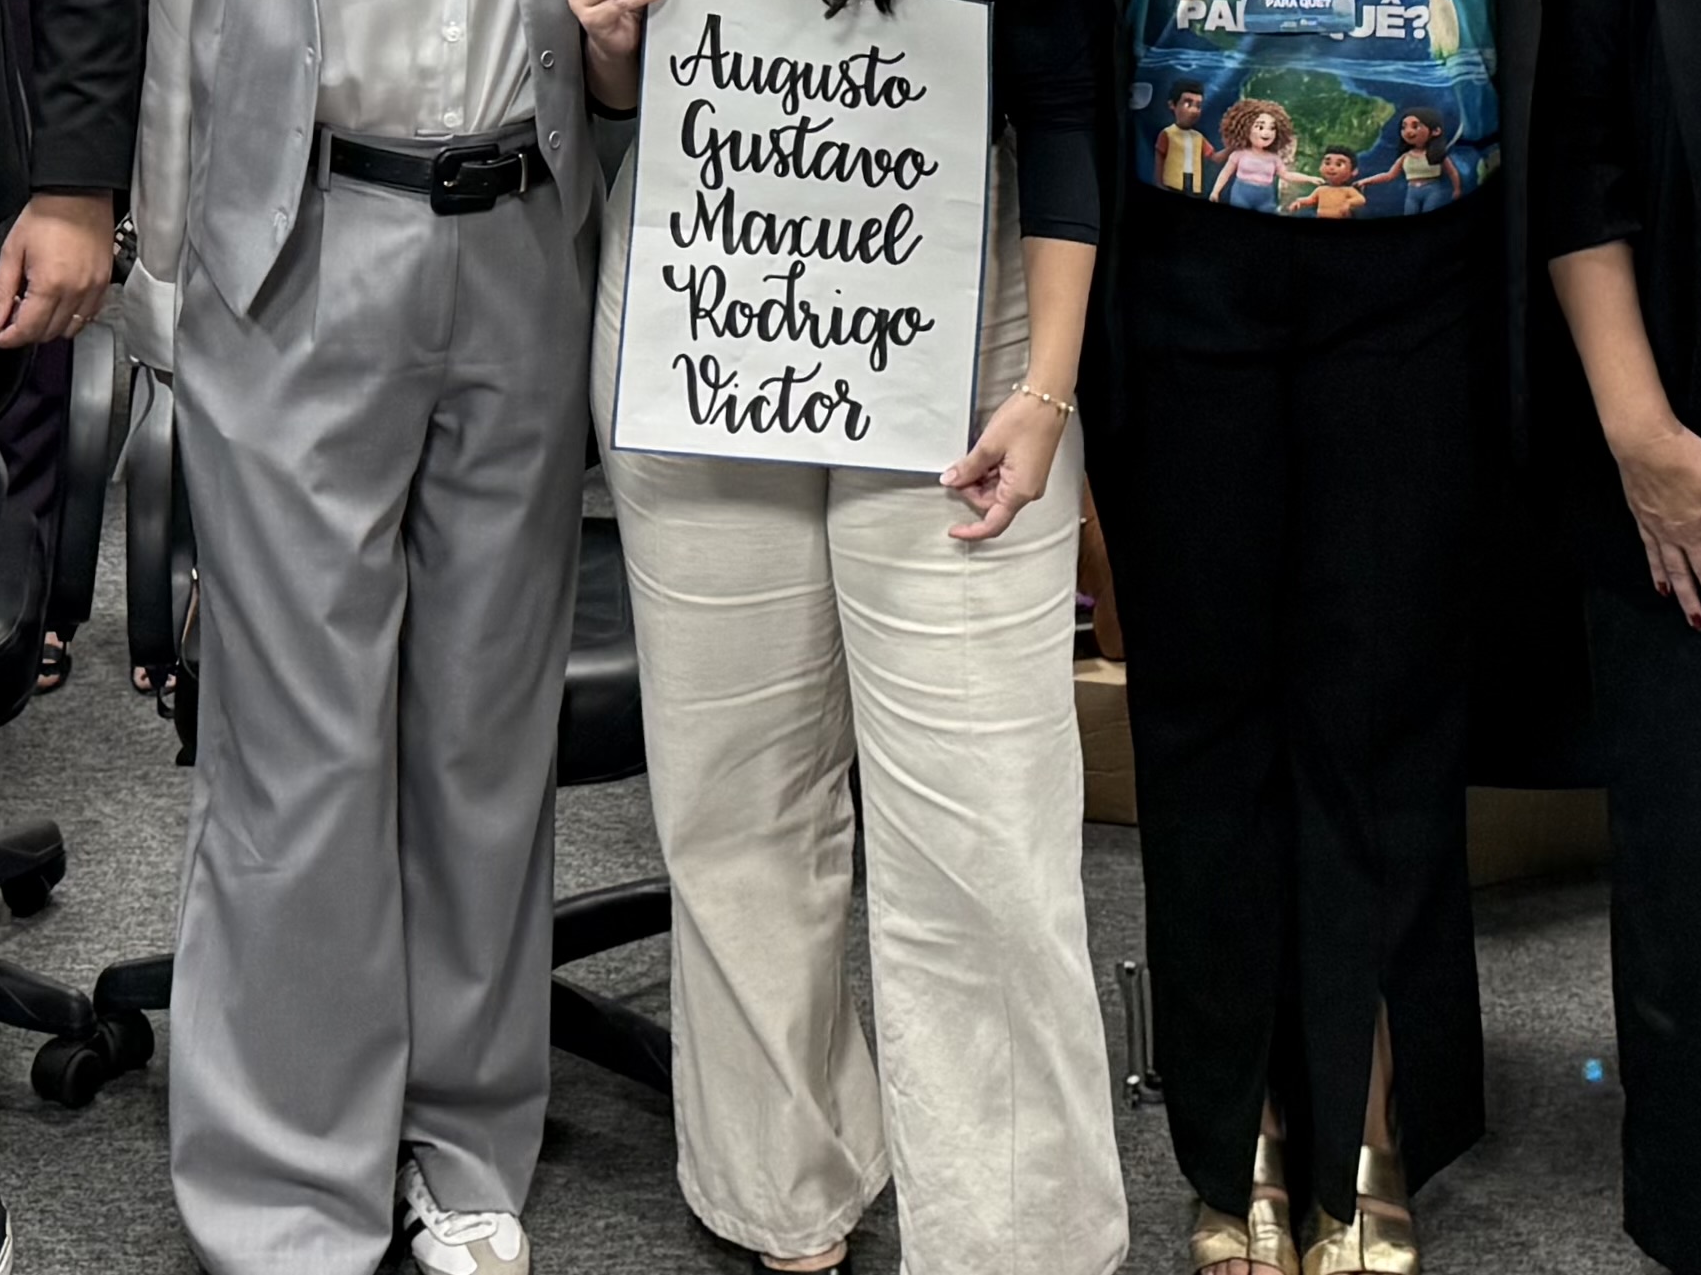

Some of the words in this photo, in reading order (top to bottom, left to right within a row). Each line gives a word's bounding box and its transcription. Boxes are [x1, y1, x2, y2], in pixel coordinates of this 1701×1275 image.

[670, 13, 927, 115] Augusto
[681, 98, 938, 190] Gustavo
[670, 187, 923, 265] Maxuel
[662, 260, 935, 372] Rodrigo
[672, 353, 871, 442] Victor
